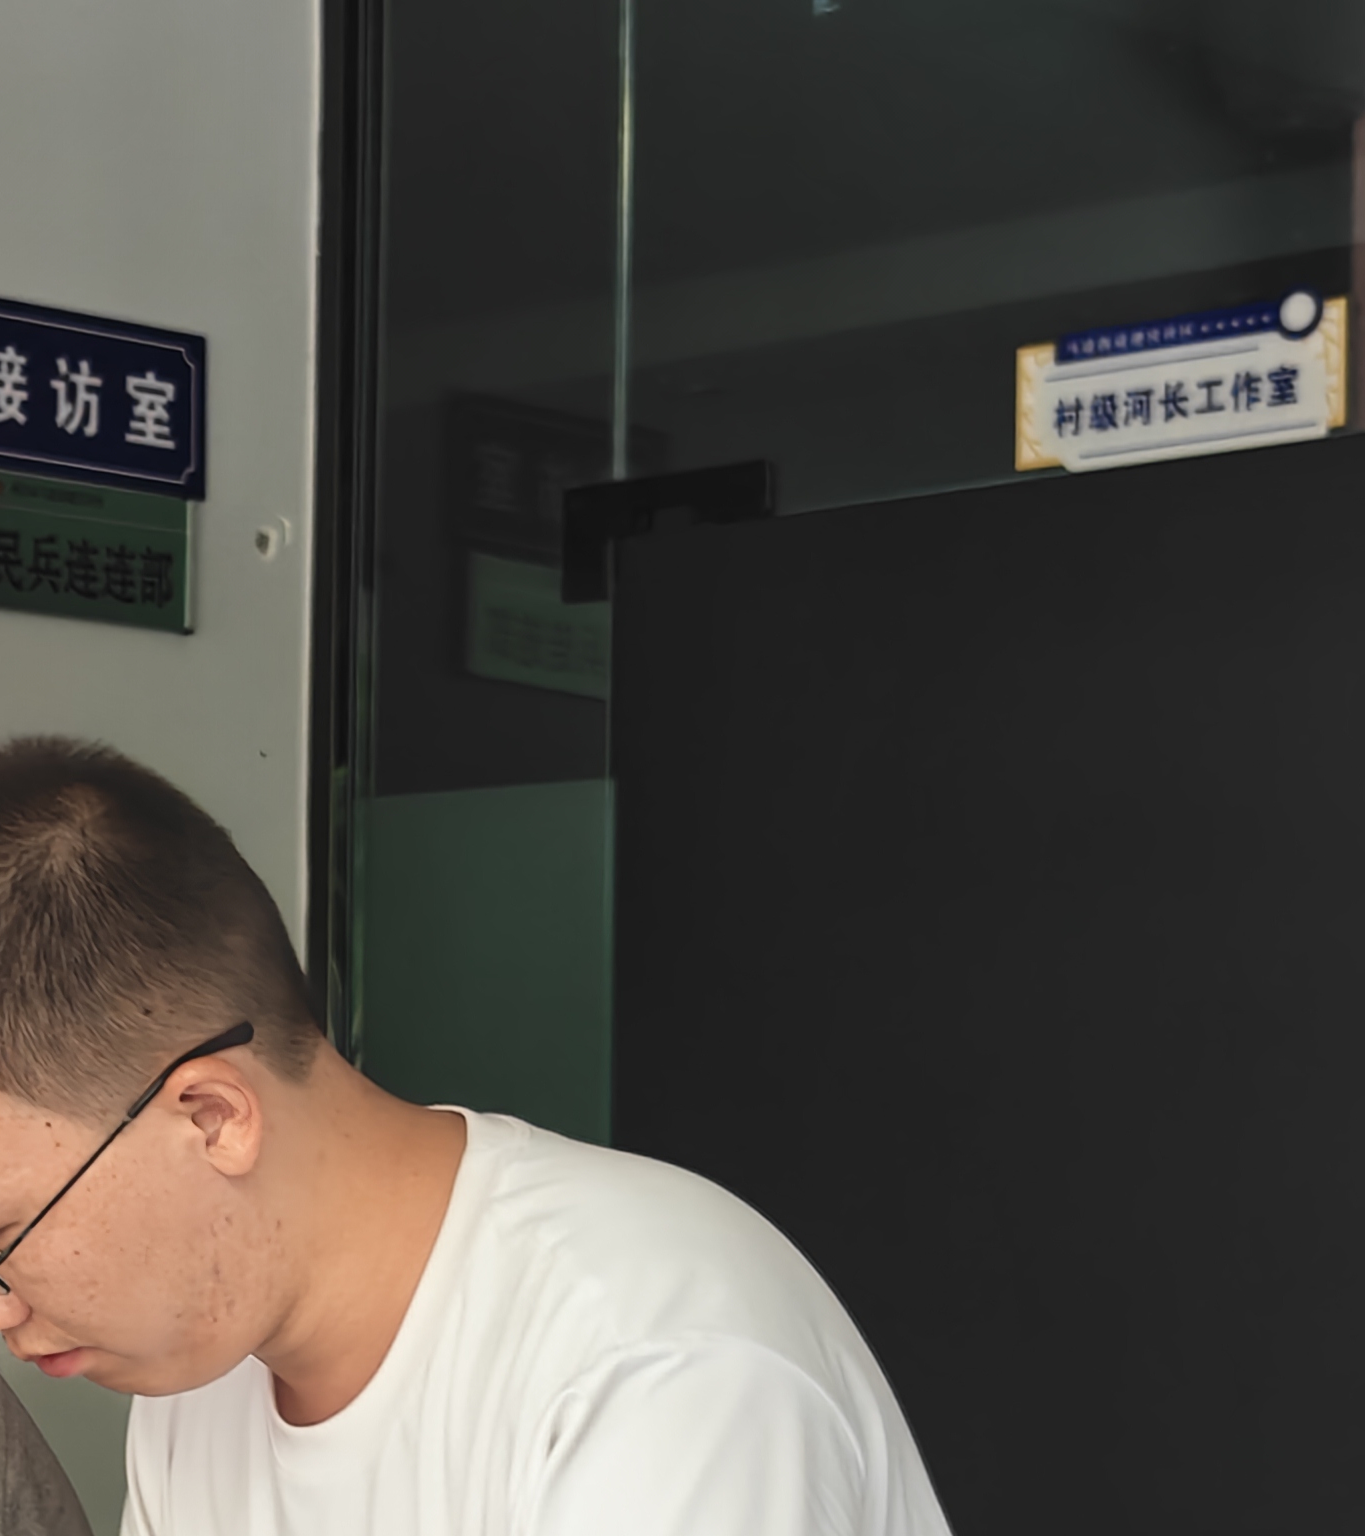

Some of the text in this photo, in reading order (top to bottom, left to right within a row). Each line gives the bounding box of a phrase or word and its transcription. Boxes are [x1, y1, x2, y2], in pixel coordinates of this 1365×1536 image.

[1052, 365, 1300, 438] 村级河长工作室
